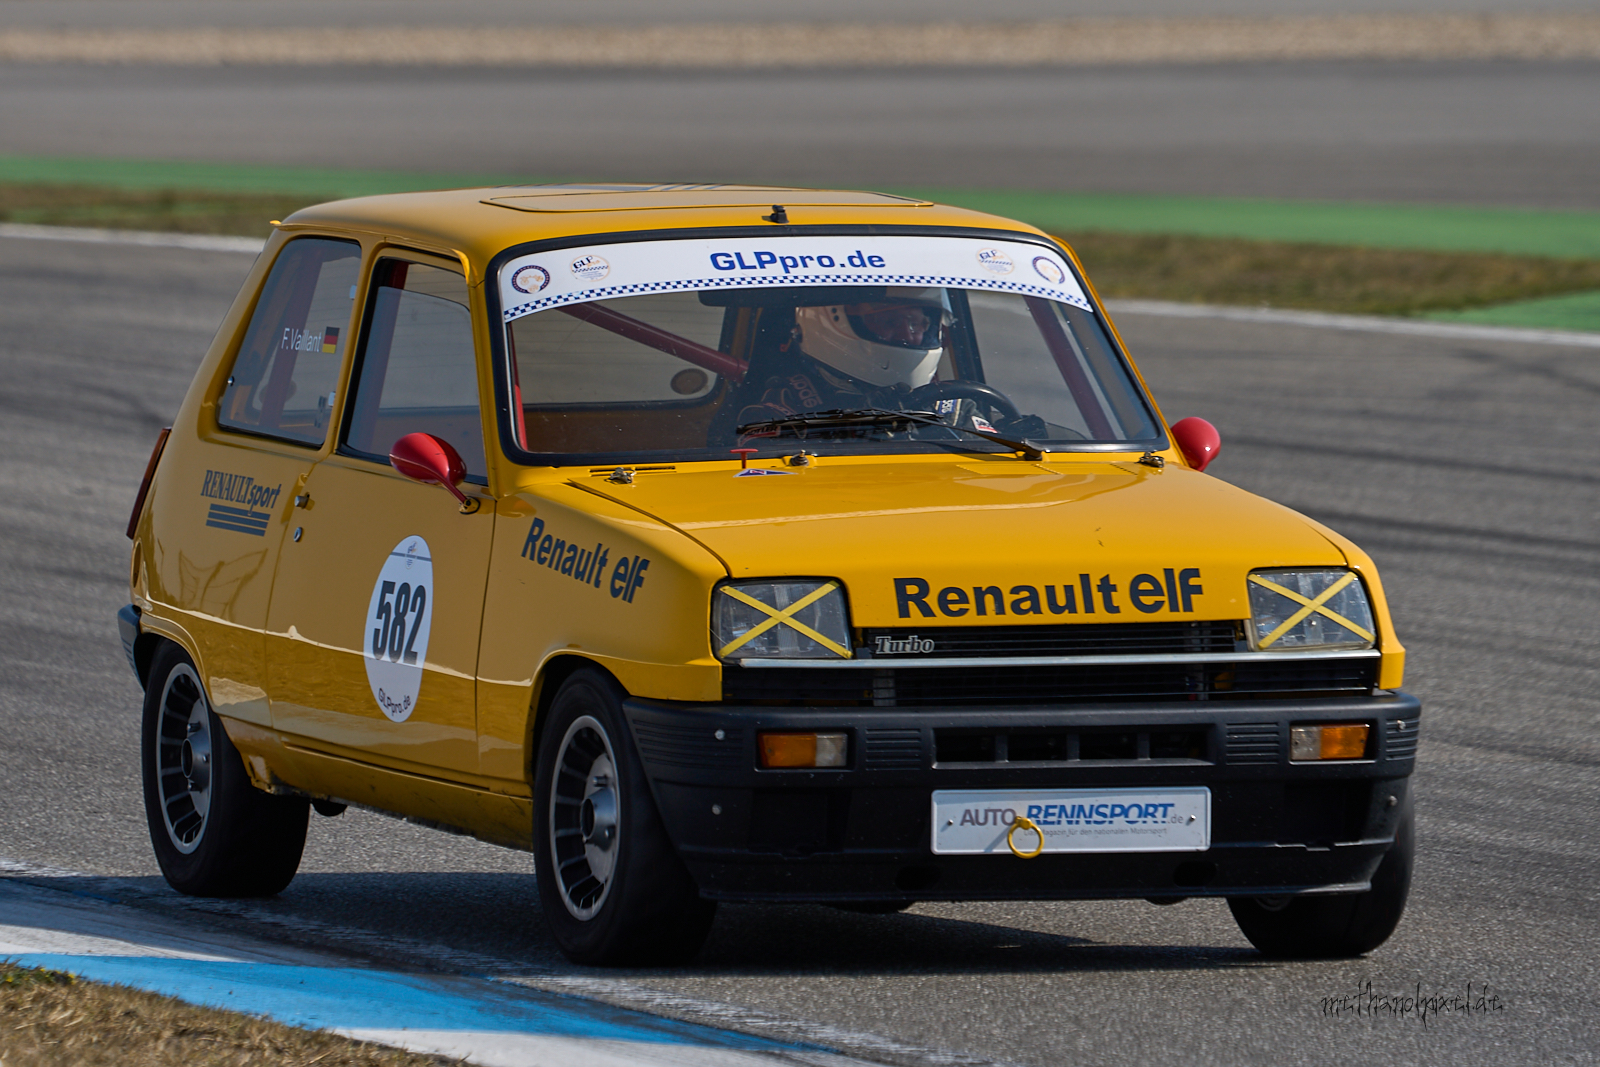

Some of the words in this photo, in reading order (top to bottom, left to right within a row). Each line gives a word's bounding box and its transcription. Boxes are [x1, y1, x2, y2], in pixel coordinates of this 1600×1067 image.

[573, 255, 594, 269] GLP
[709, 250, 886, 273] GLPpro.de
[521, 517, 610, 589] Renault
[610, 555, 651, 604] elf
[893, 574, 1121, 619] Renault
[1129, 568, 1204, 614] elf
[372, 580, 426, 666] 582
[875, 635, 935, 654] Turbo
